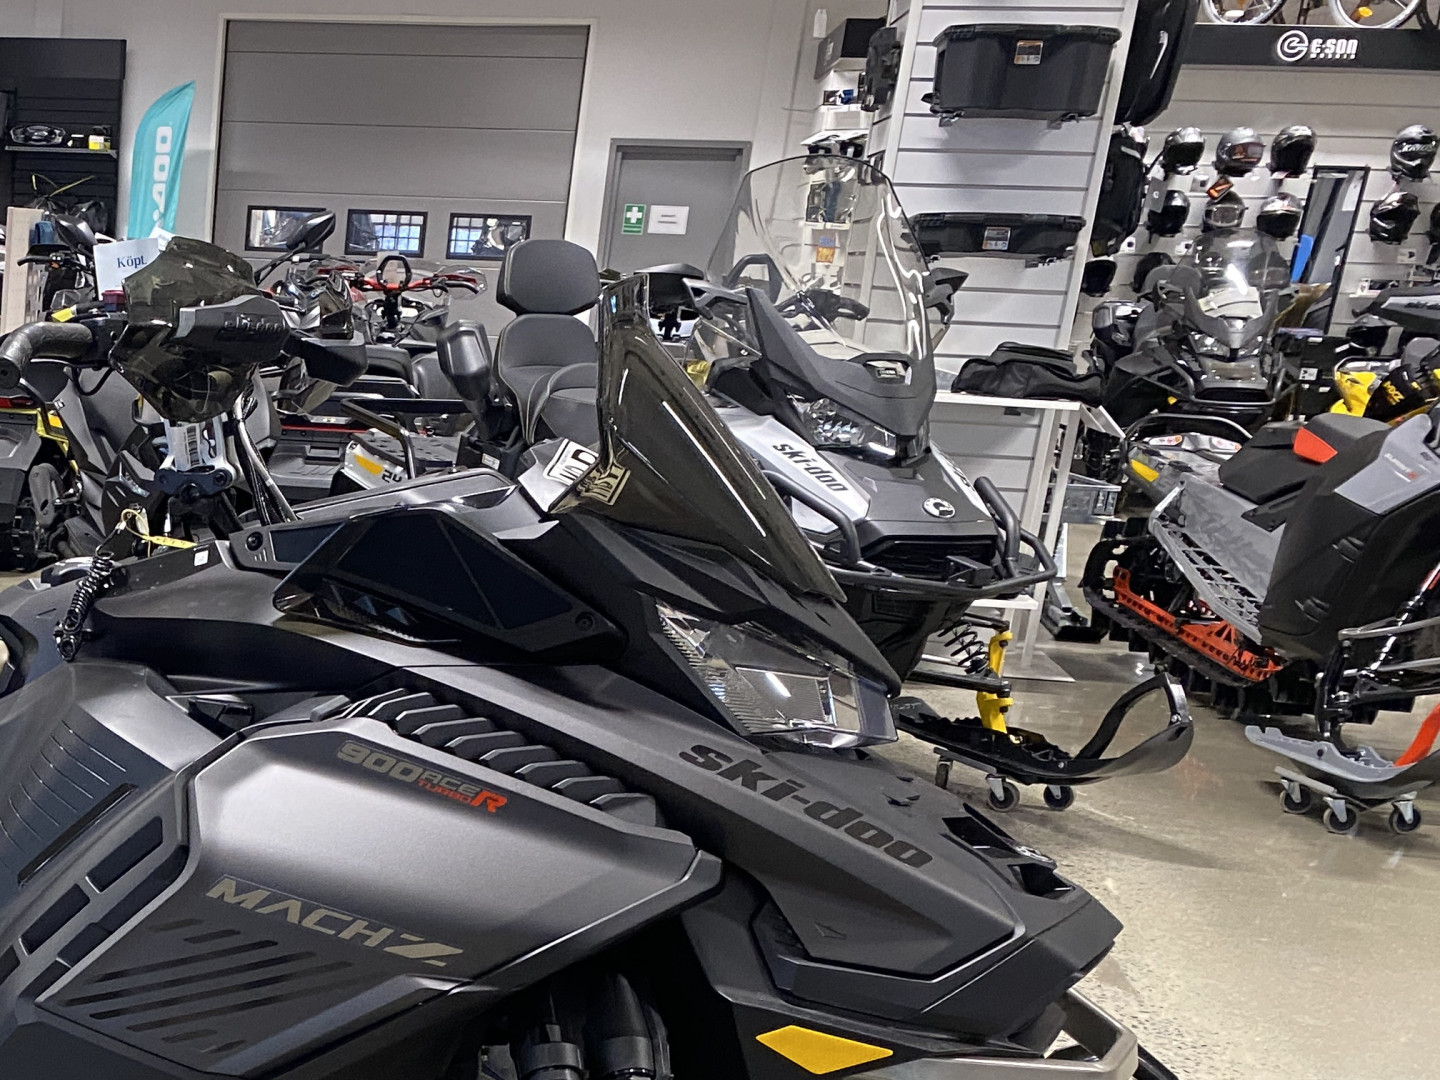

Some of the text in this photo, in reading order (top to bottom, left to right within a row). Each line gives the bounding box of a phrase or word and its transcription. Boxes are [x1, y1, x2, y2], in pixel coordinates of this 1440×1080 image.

[772, 442, 848, 493] ski-doo
[336, 741, 508, 814] 900 ACE R
[417, 779, 473, 805] TURBO
[679, 744, 933, 869] ski-doo
[205, 877, 395, 948] MACH
